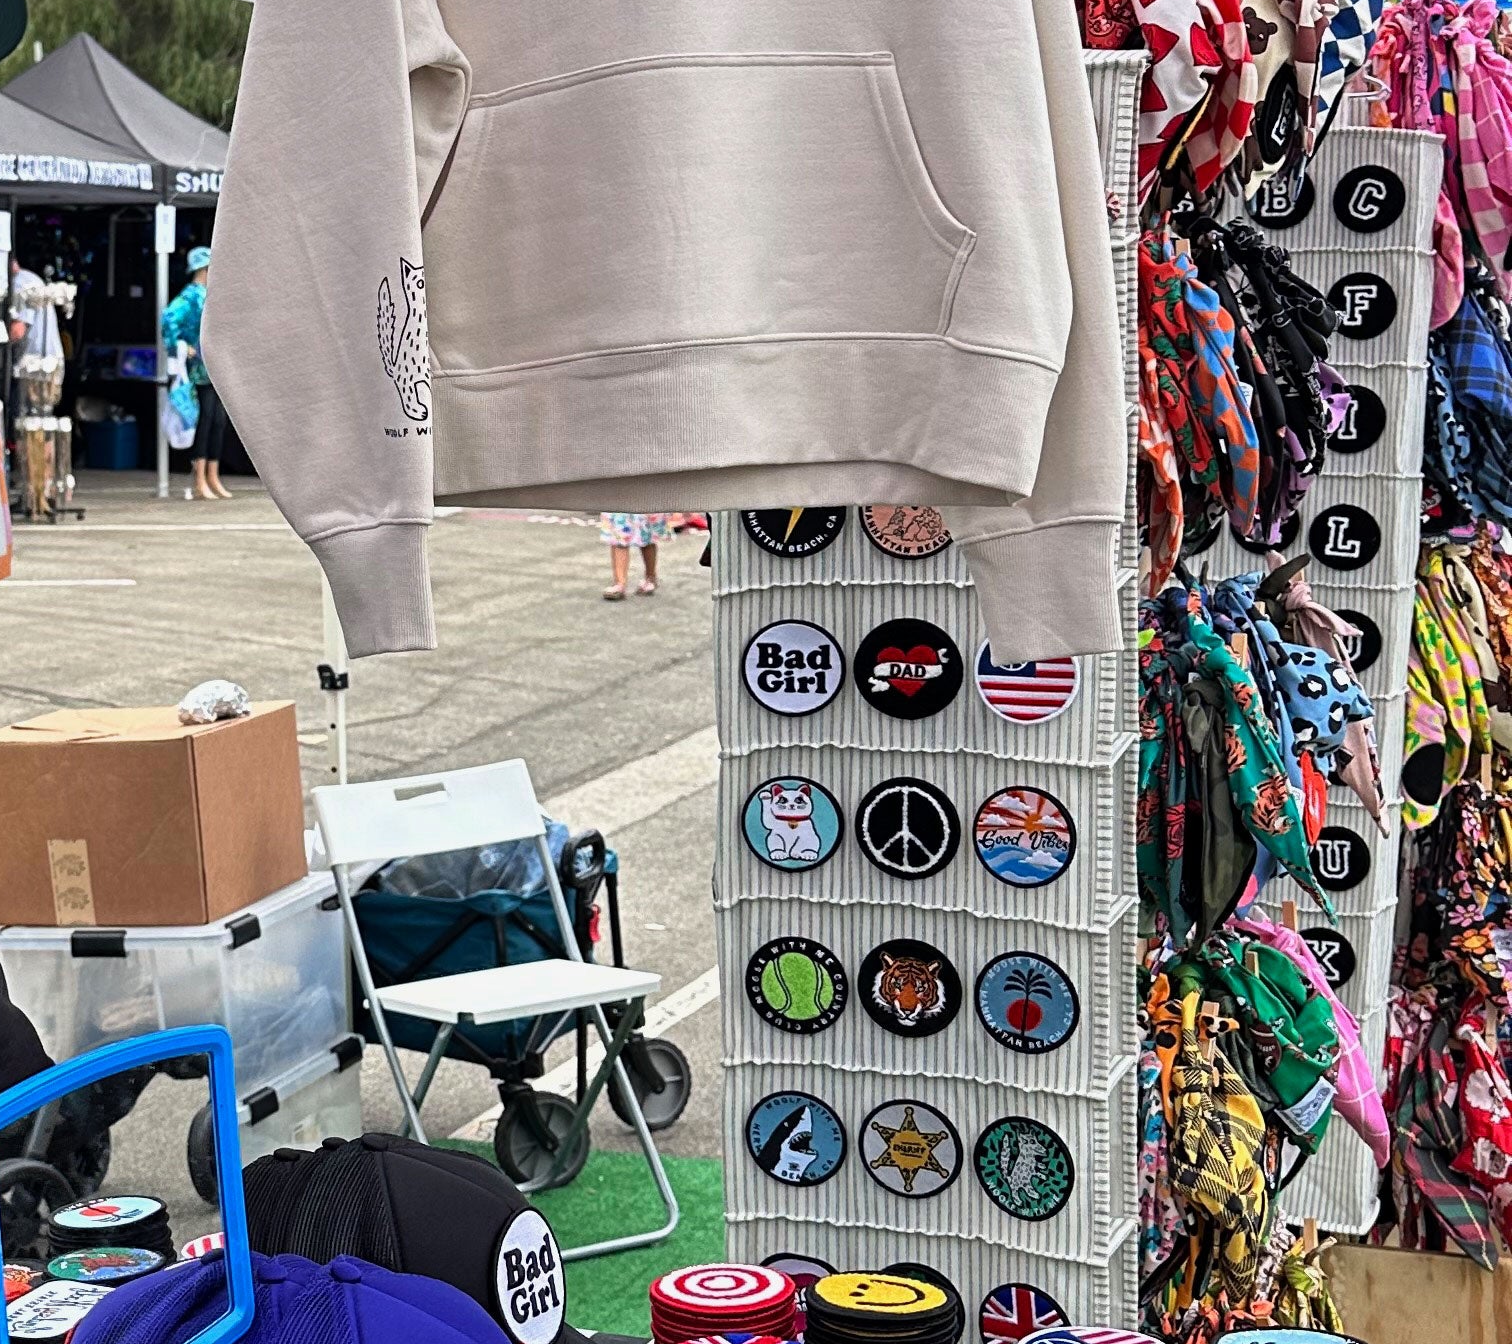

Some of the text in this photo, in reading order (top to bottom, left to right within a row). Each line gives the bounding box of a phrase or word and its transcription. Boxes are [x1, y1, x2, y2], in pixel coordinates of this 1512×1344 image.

[1348, 178, 1388, 220] C
[1342, 284, 1378, 327] F
[826, 515, 838, 529] CA
[1325, 517, 1361, 559] L
[756, 642, 832, 670] Bad
[890, 662, 927, 679] DAD
[757, 669, 828, 695] Girl
[977, 829, 1069, 852] Good Vibes
[1316, 839, 1352, 880] U
[503, 1232, 556, 1291] Bad
[510, 1274, 560, 1325] Girl
